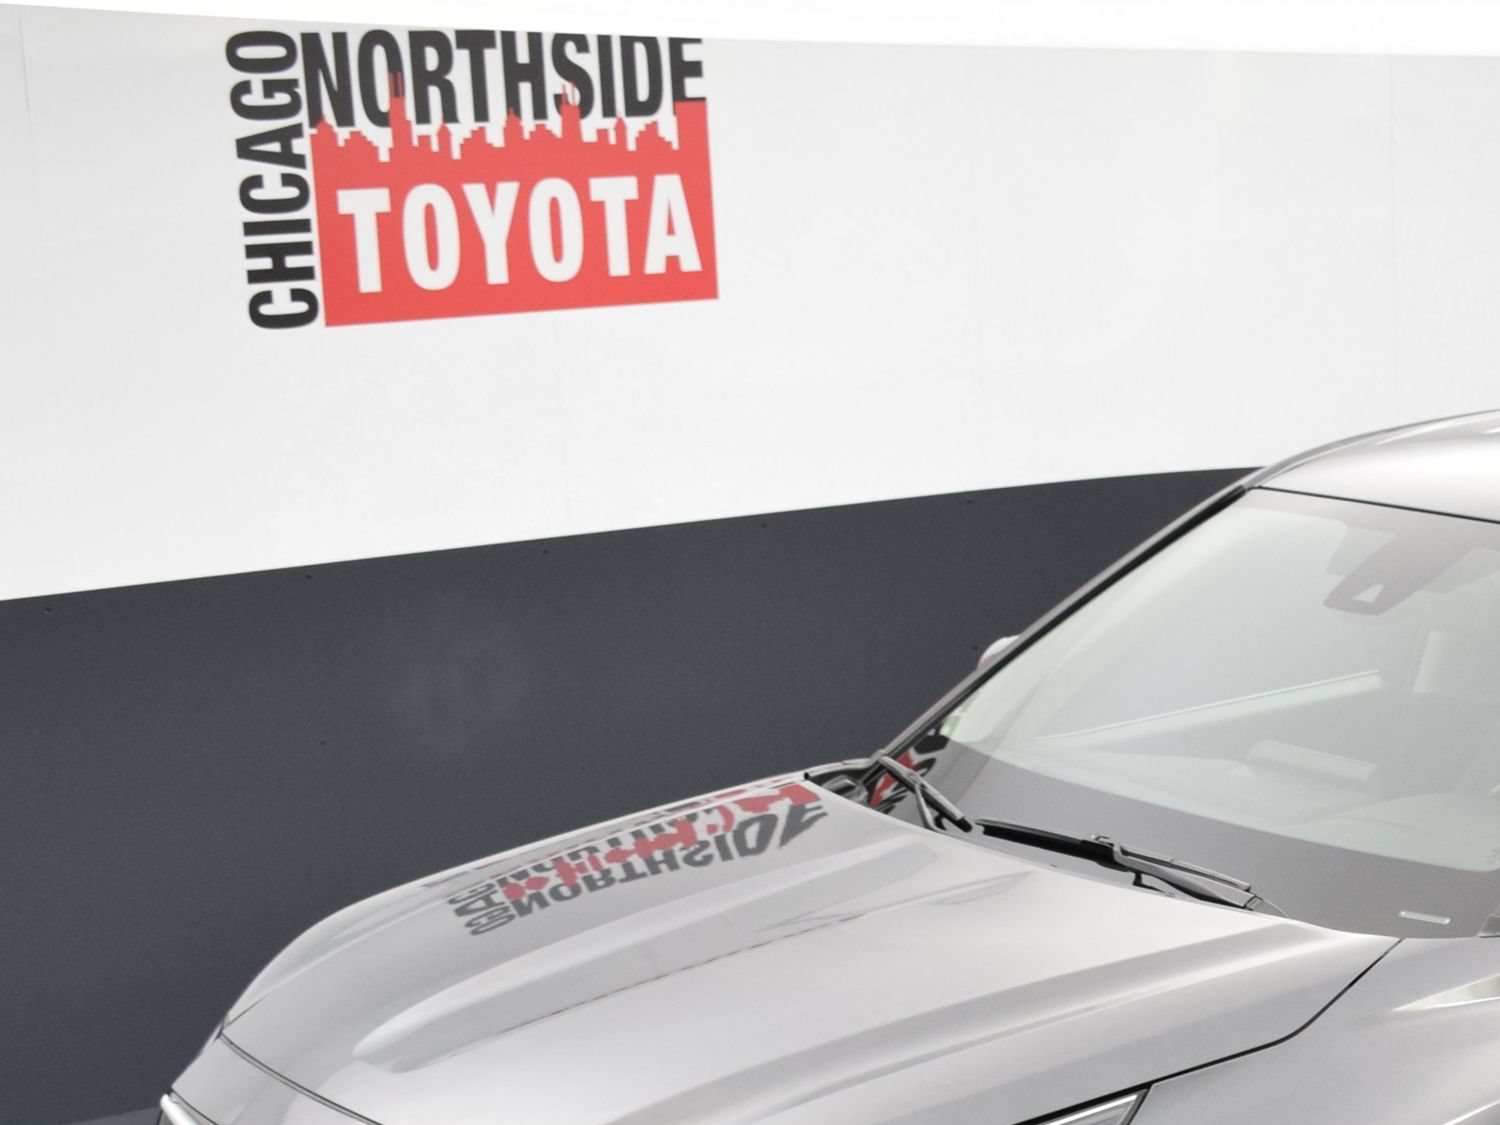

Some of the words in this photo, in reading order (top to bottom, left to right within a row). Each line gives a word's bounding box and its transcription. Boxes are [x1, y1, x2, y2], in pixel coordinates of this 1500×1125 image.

[300, 29, 707, 128] NORTHSIDE
[225, 30, 319, 329] CHICAGO
[336, 174, 702, 294] TOYOTA
